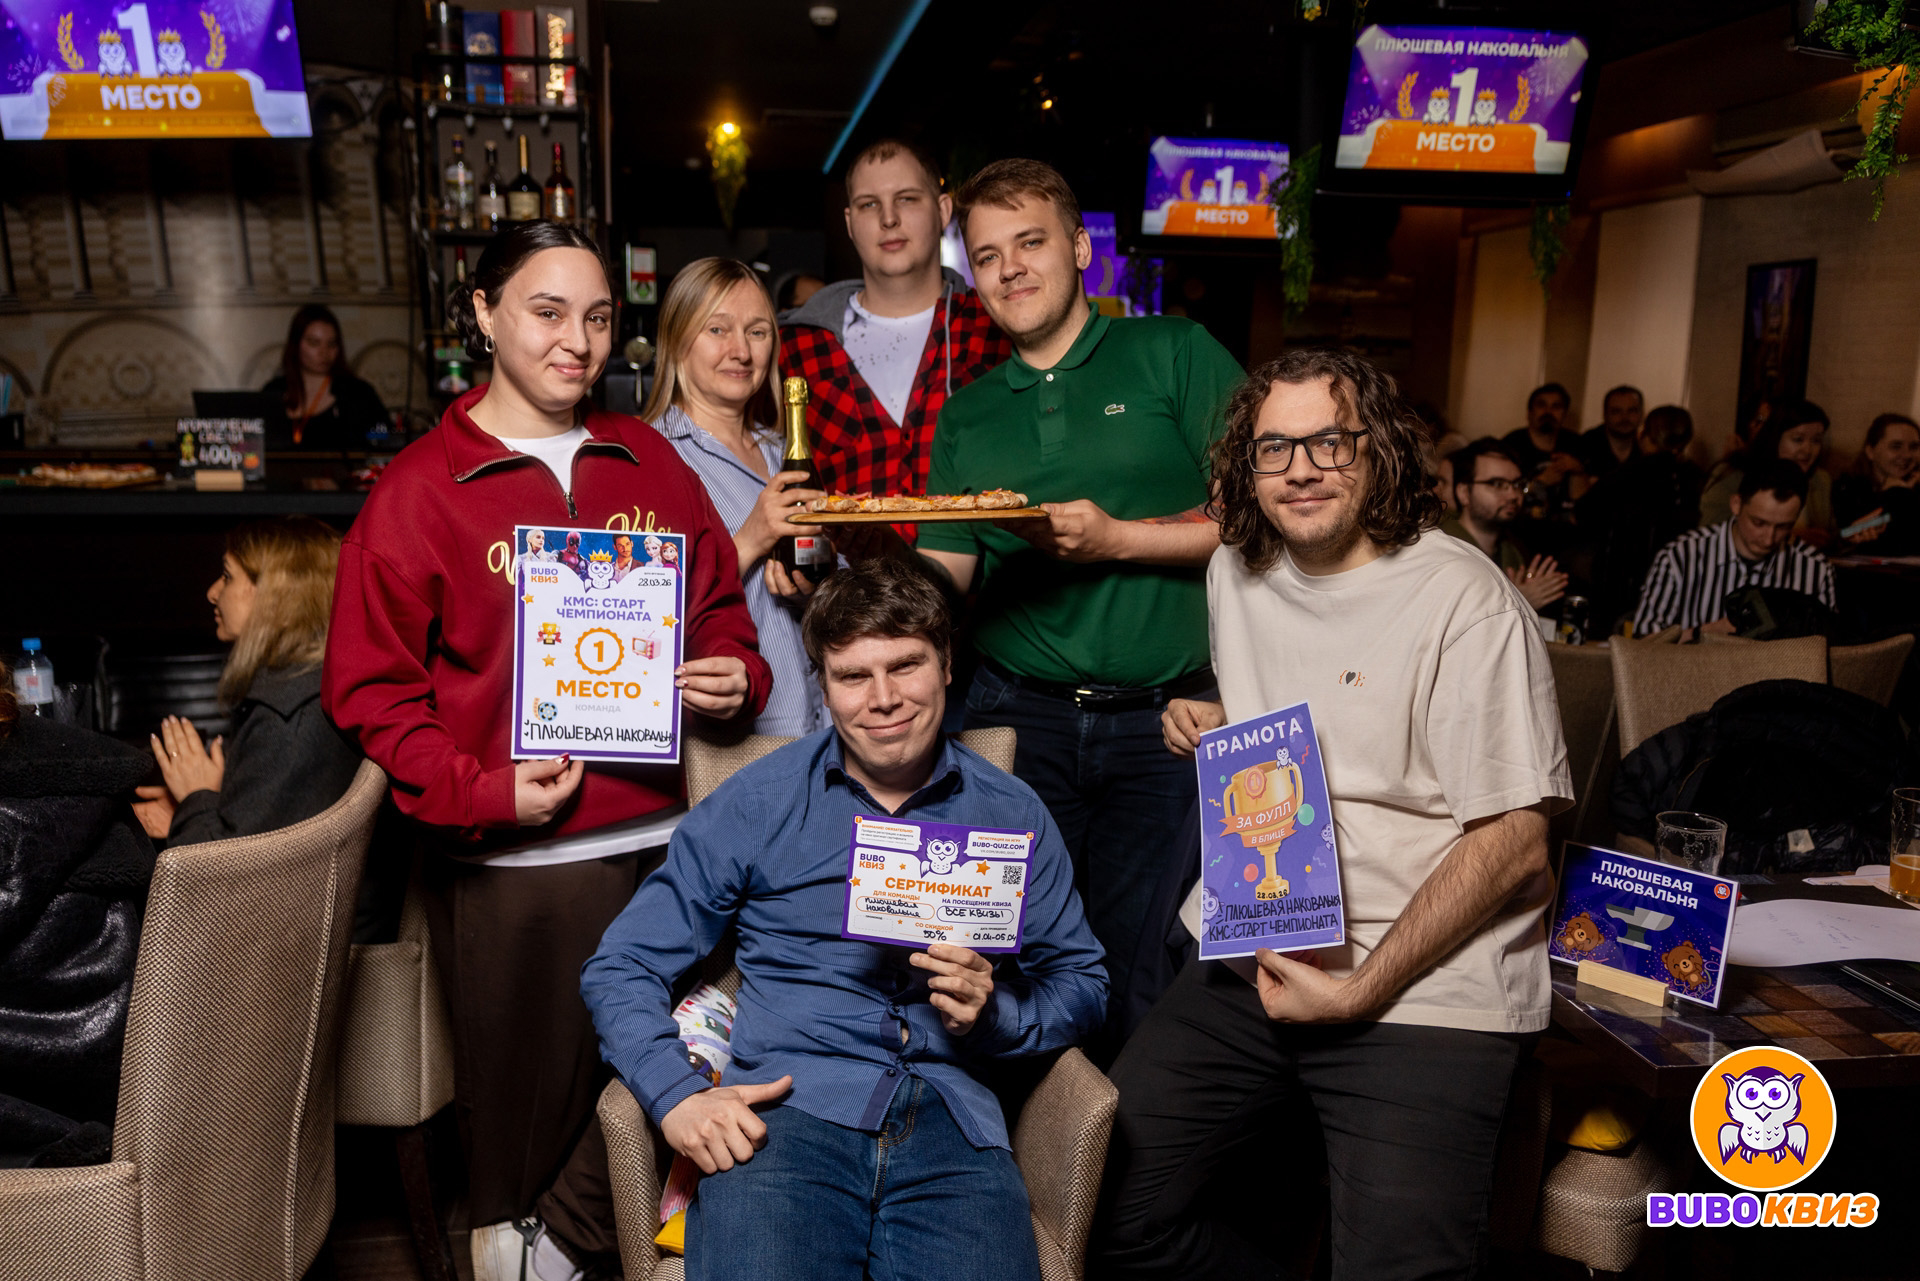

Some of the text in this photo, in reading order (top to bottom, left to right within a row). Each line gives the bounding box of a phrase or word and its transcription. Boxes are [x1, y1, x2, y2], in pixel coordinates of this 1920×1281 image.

[117, 3, 159, 78] 1
[1375, 38, 1569, 58] ПЛЮШЕВАЯ НАКОВАЛЬНЯ
[100, 84, 202, 110] МЕСТО
[1451, 67, 1479, 127] 1
[1416, 132, 1495, 152] МЕСТО
[1215, 165, 1235, 206] 1
[1195, 209, 1249, 225] МЕСТО
[531, 567, 559, 575] BUBO
[637, 578, 672, 587] 28.03.26
[563, 596, 646, 609] КМС: СТАРТ
[556, 608, 652, 622] ЧЕМПИОНАТА
[593, 640, 604, 663] 1
[556, 680, 641, 699] МЕСТО
[575, 704, 621, 713] КОМАНДА
[1205, 717, 1304, 760] ГРАМОТА
[1236, 801, 1291, 829] ЗА ФУЛЛ
[1251, 828, 1286, 844] В БЛИЦЕ
[972, 841, 1025, 850] BUBO-QUIZ.COM
[859, 861, 885, 870] КВИЗ
[860, 853, 885, 862] BUBO
[1600, 860, 1693, 893] ПЛЮШЕВАЯ
[872, 890, 920, 901] ДЛЯ КОМАНДЫ
[885, 877, 992, 898] СЕРТИФИКАТ
[1591, 872, 1698, 910] НАКОВАЛЬНЯ
[952, 899, 990, 907] ПОСЕЩЕНИЕ
[945, 907, 967, 917] ВСЕ
[925, 922, 954, 931] СКИДКОЙ
[1270, 913, 1339, 934] ЧЕМПИОНАТА
[923, 929, 947, 941] 50%
